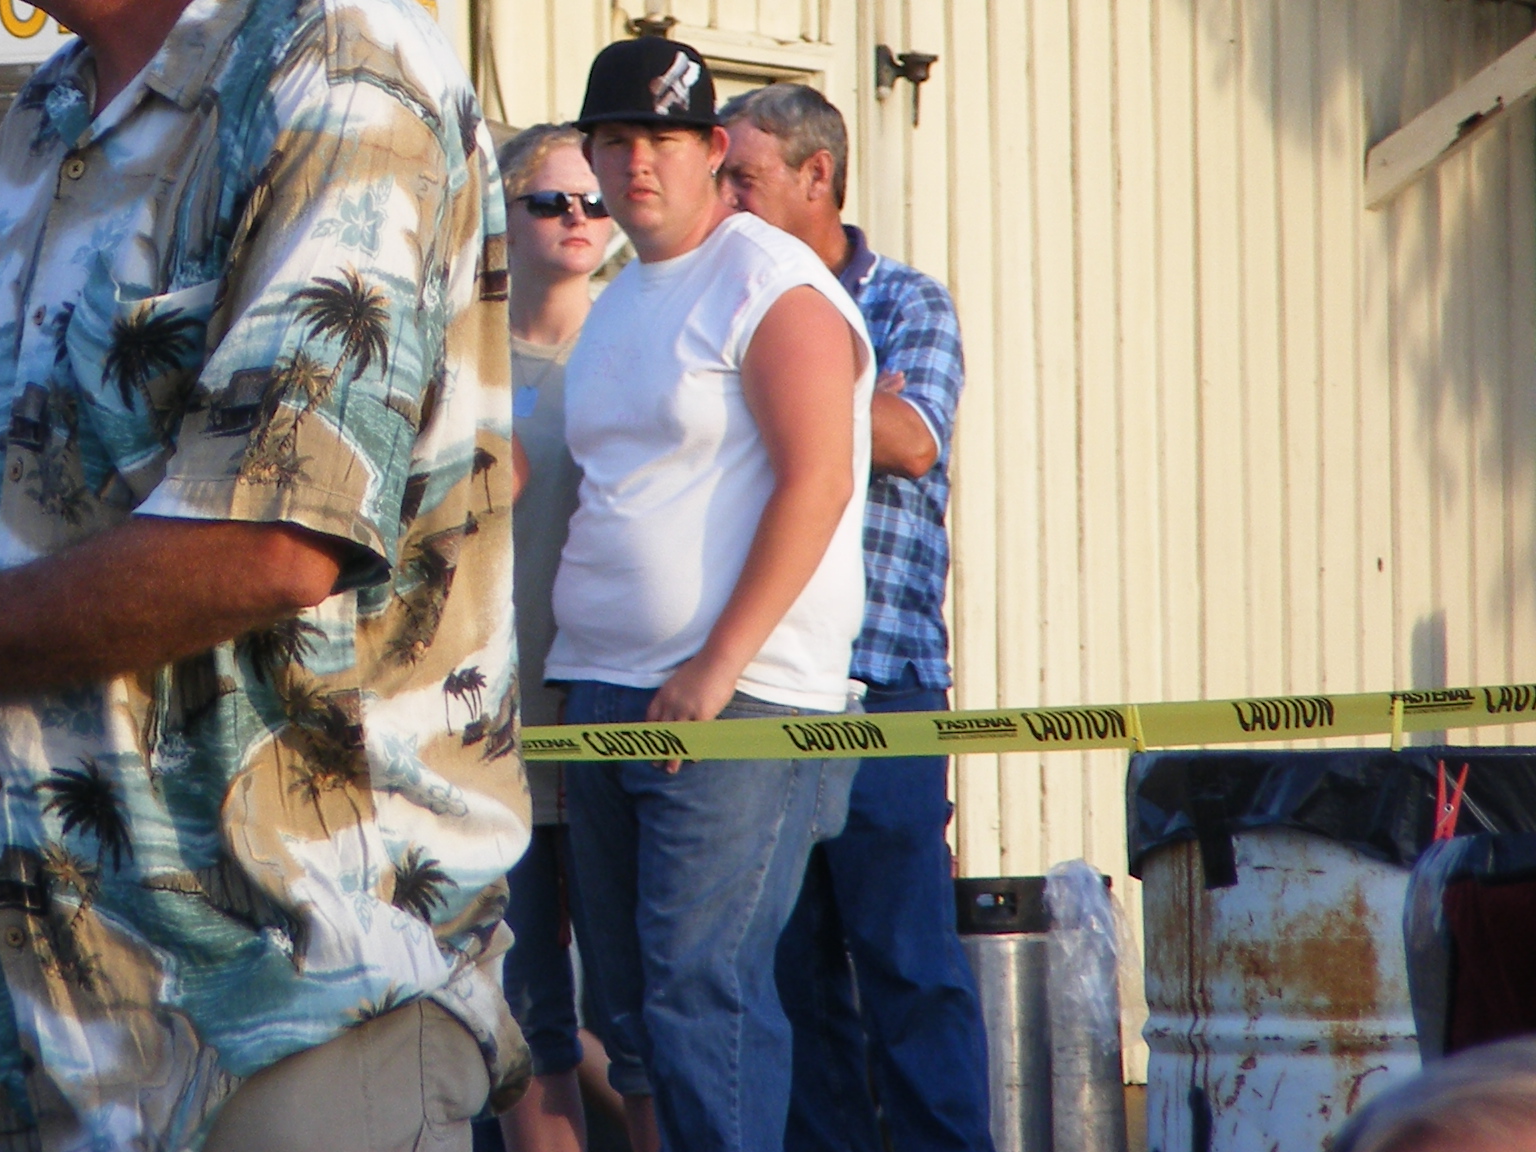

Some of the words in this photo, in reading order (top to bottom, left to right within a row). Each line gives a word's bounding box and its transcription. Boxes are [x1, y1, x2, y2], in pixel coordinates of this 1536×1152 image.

[581, 729, 690, 757] CAUTION
[781, 719, 888, 751] CAUTION
[1021, 708, 1127, 742] CAUTION
[1231, 697, 1334, 732] CAUTION
